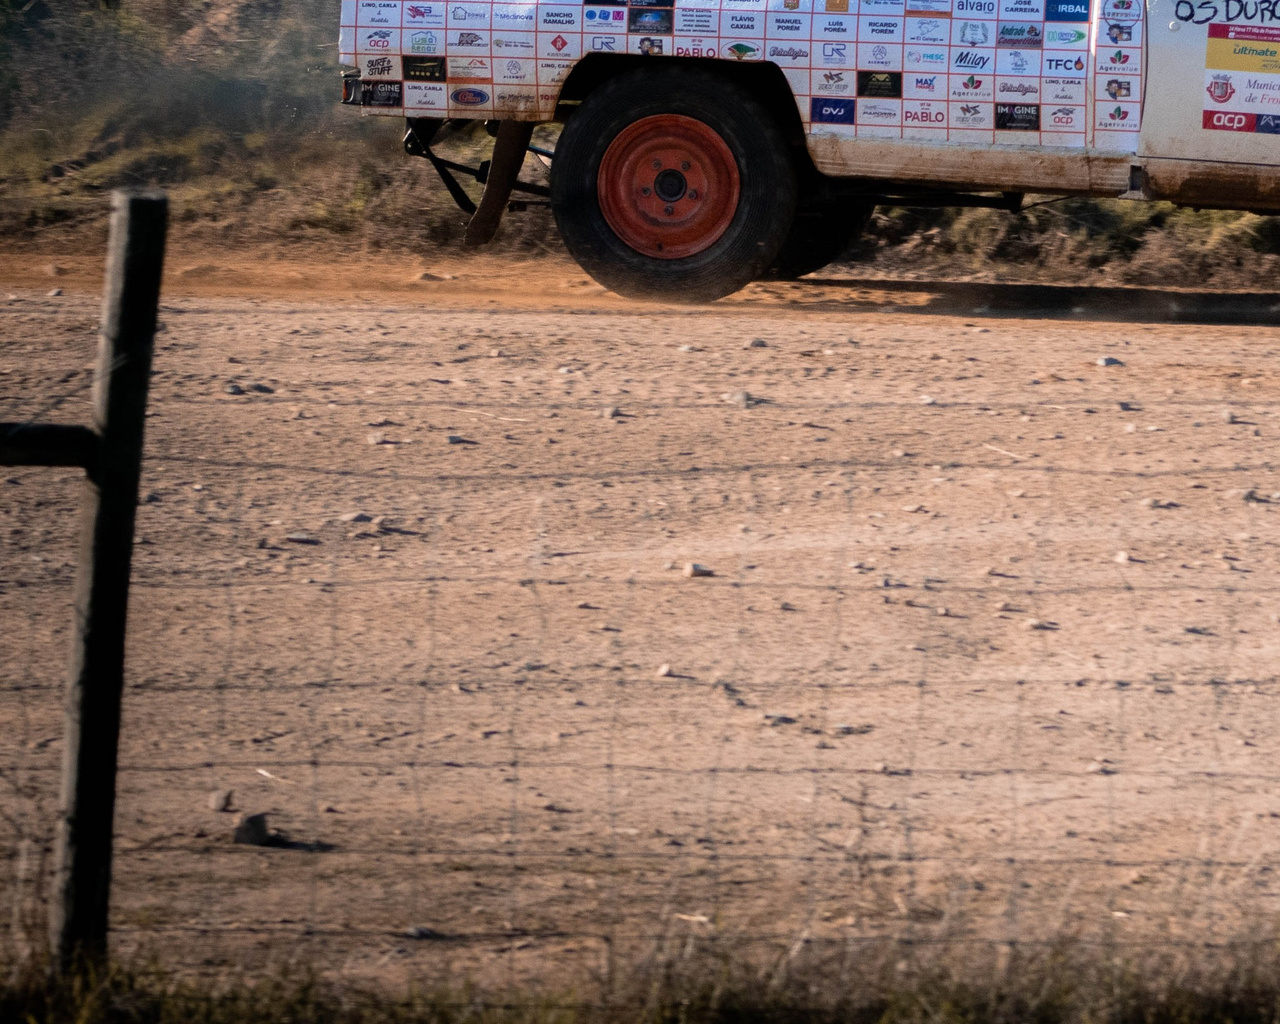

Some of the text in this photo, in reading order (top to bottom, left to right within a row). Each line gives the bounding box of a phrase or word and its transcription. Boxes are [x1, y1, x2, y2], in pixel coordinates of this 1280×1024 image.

[1005, 6, 1040, 14] CARREIRA
[1058, 4, 1088, 13] IRBAL
[1175, 0, 1218, 24] OS
[1000, 25, 1025, 36] Andrade
[370, 40, 390, 50] acp
[998, 37, 1042, 46] Competition
[676, 47, 716, 58] PABLO
[1234, 46, 1278, 56] ultimate
[367, 58, 386, 68] SURF
[955, 52, 990, 69] Milay
[1046, 58, 1073, 70] TFC
[368, 66, 392, 76] STUFF
[916, 76, 936, 85] MAX
[1245, 93, 1257, 104] de
[998, 106, 1036, 114] IMAGINE
[904, 111, 944, 122] PABLO
[1053, 116, 1073, 126] acp
[1213, 114, 1246, 129] acp
